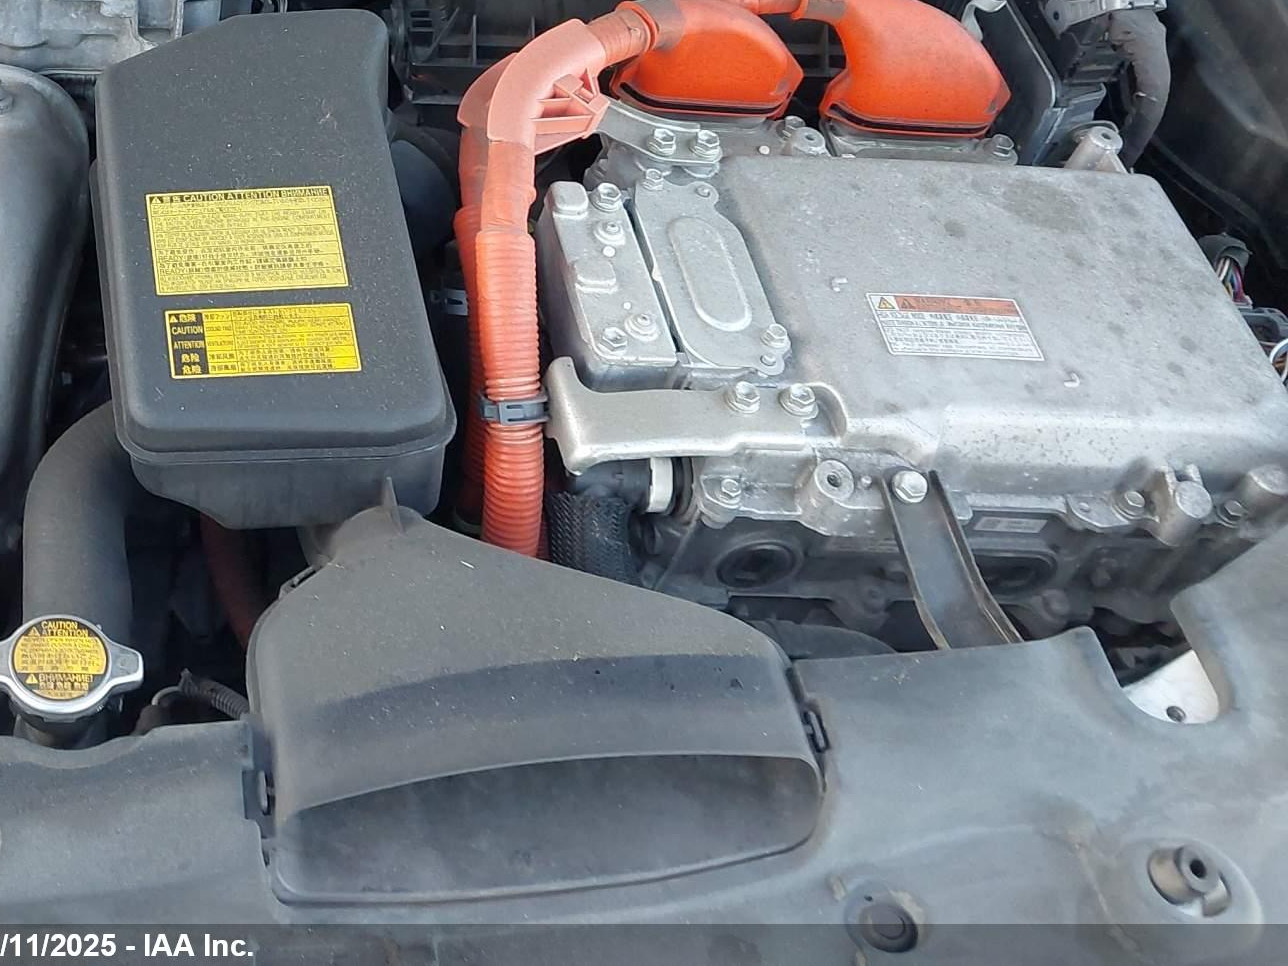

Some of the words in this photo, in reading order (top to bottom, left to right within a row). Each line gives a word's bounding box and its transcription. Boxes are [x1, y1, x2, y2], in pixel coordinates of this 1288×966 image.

[183, 192, 225, 203] CAUTION
[227, 189, 279, 201] ATTENTION
[171, 325, 203, 335] CAUTION
[173, 340, 205, 349] ATTENTION
[41, 621, 78, 630] CAUTION
[41, 629, 89, 638] ATTENTION
